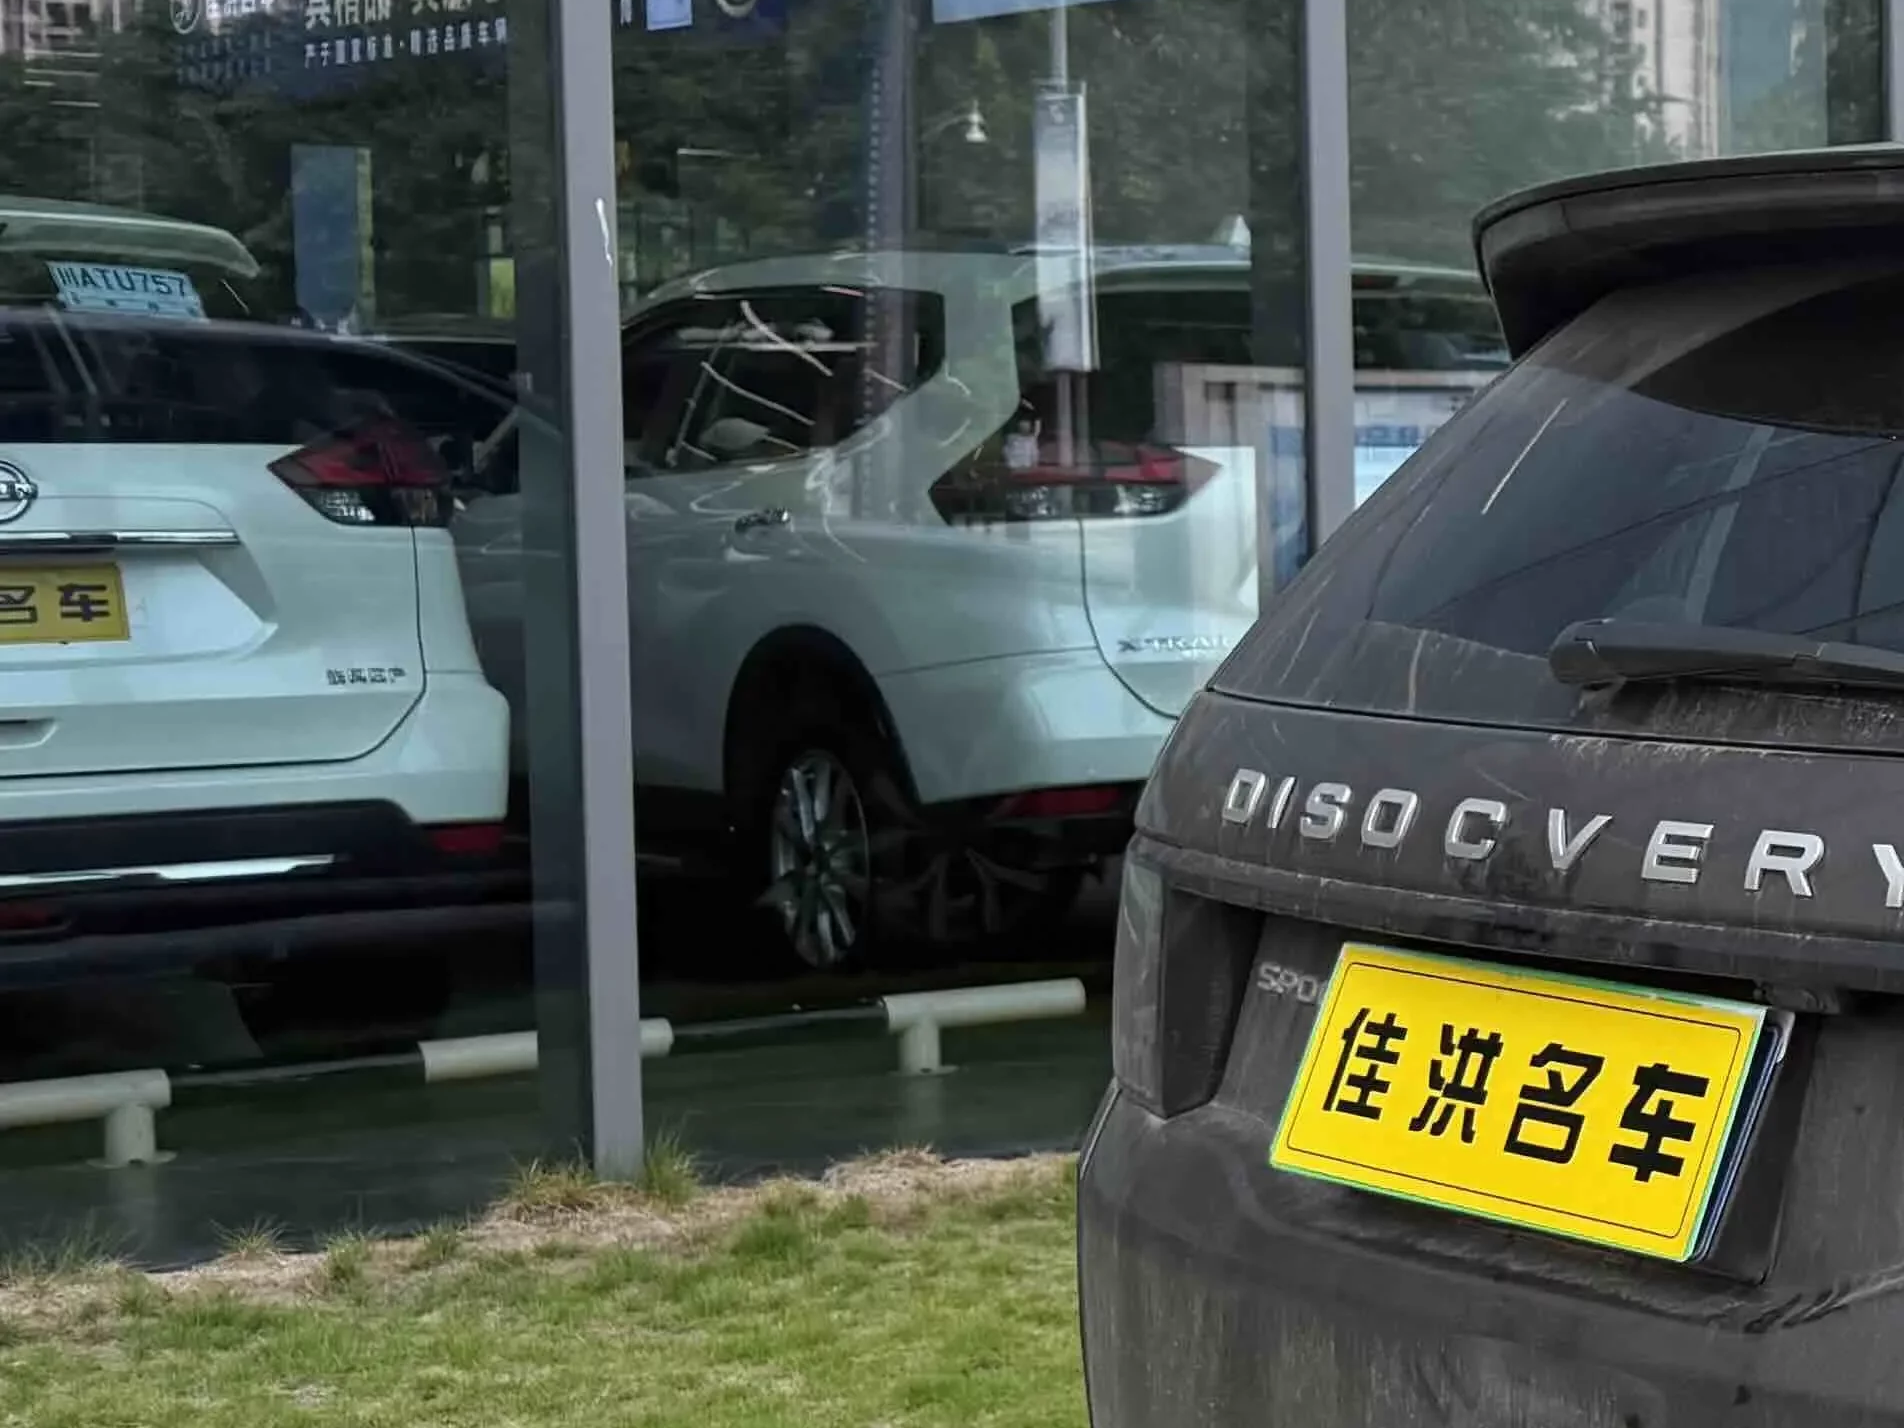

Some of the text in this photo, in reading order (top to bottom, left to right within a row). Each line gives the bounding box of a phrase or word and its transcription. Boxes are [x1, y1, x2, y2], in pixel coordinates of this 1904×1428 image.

[1257, 962, 1327, 1003] SPO
[1322, 1007, 1712, 1183] 佳洪名车
